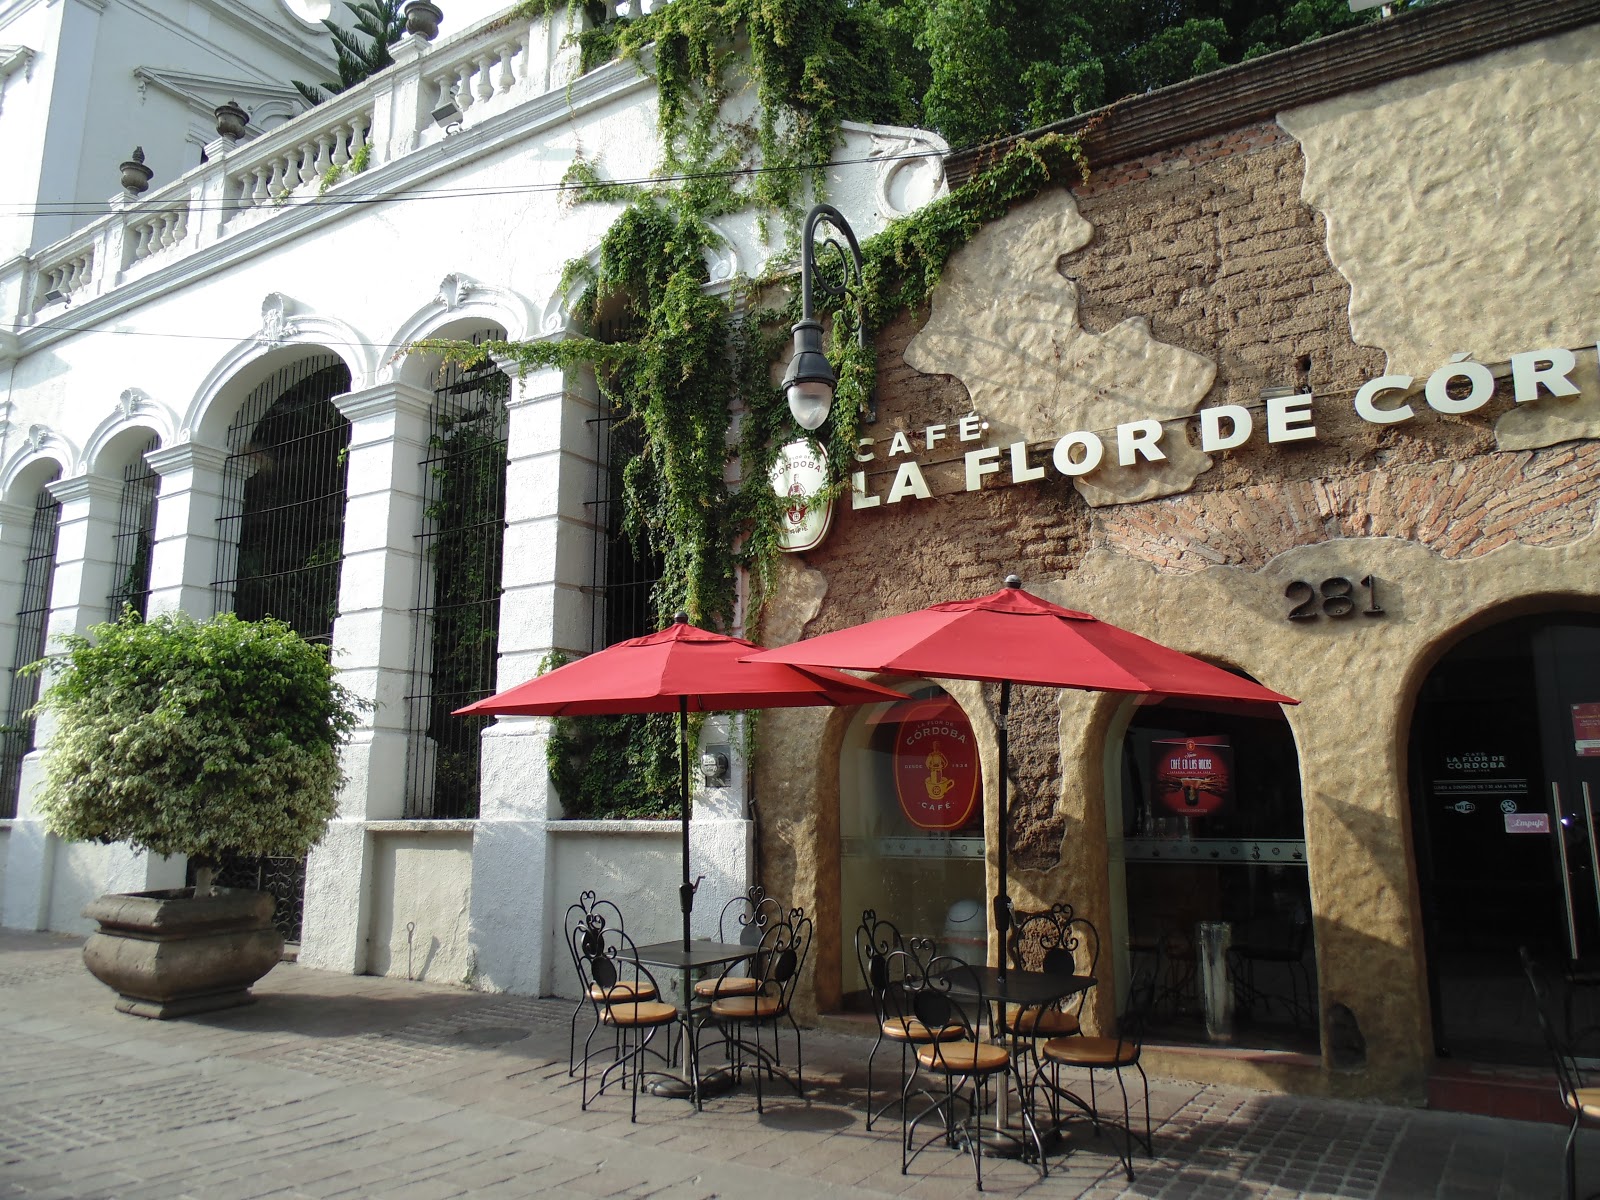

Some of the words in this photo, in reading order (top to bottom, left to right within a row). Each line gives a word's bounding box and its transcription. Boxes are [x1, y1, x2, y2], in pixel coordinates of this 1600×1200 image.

[851, 461, 935, 511] LA
[964, 418, 1167, 492] FLOR
[1200, 392, 1317, 453] DE
[1354, 340, 1600, 425] CÓR
[856, 413, 980, 462] CAFÉ
[1284, 574, 1386, 622] 281
[906, 726, 967, 746] CÓRDOBA
[1462, 755, 1488, 763] FLOR
[921, 800, 951, 811] CAFÉ
